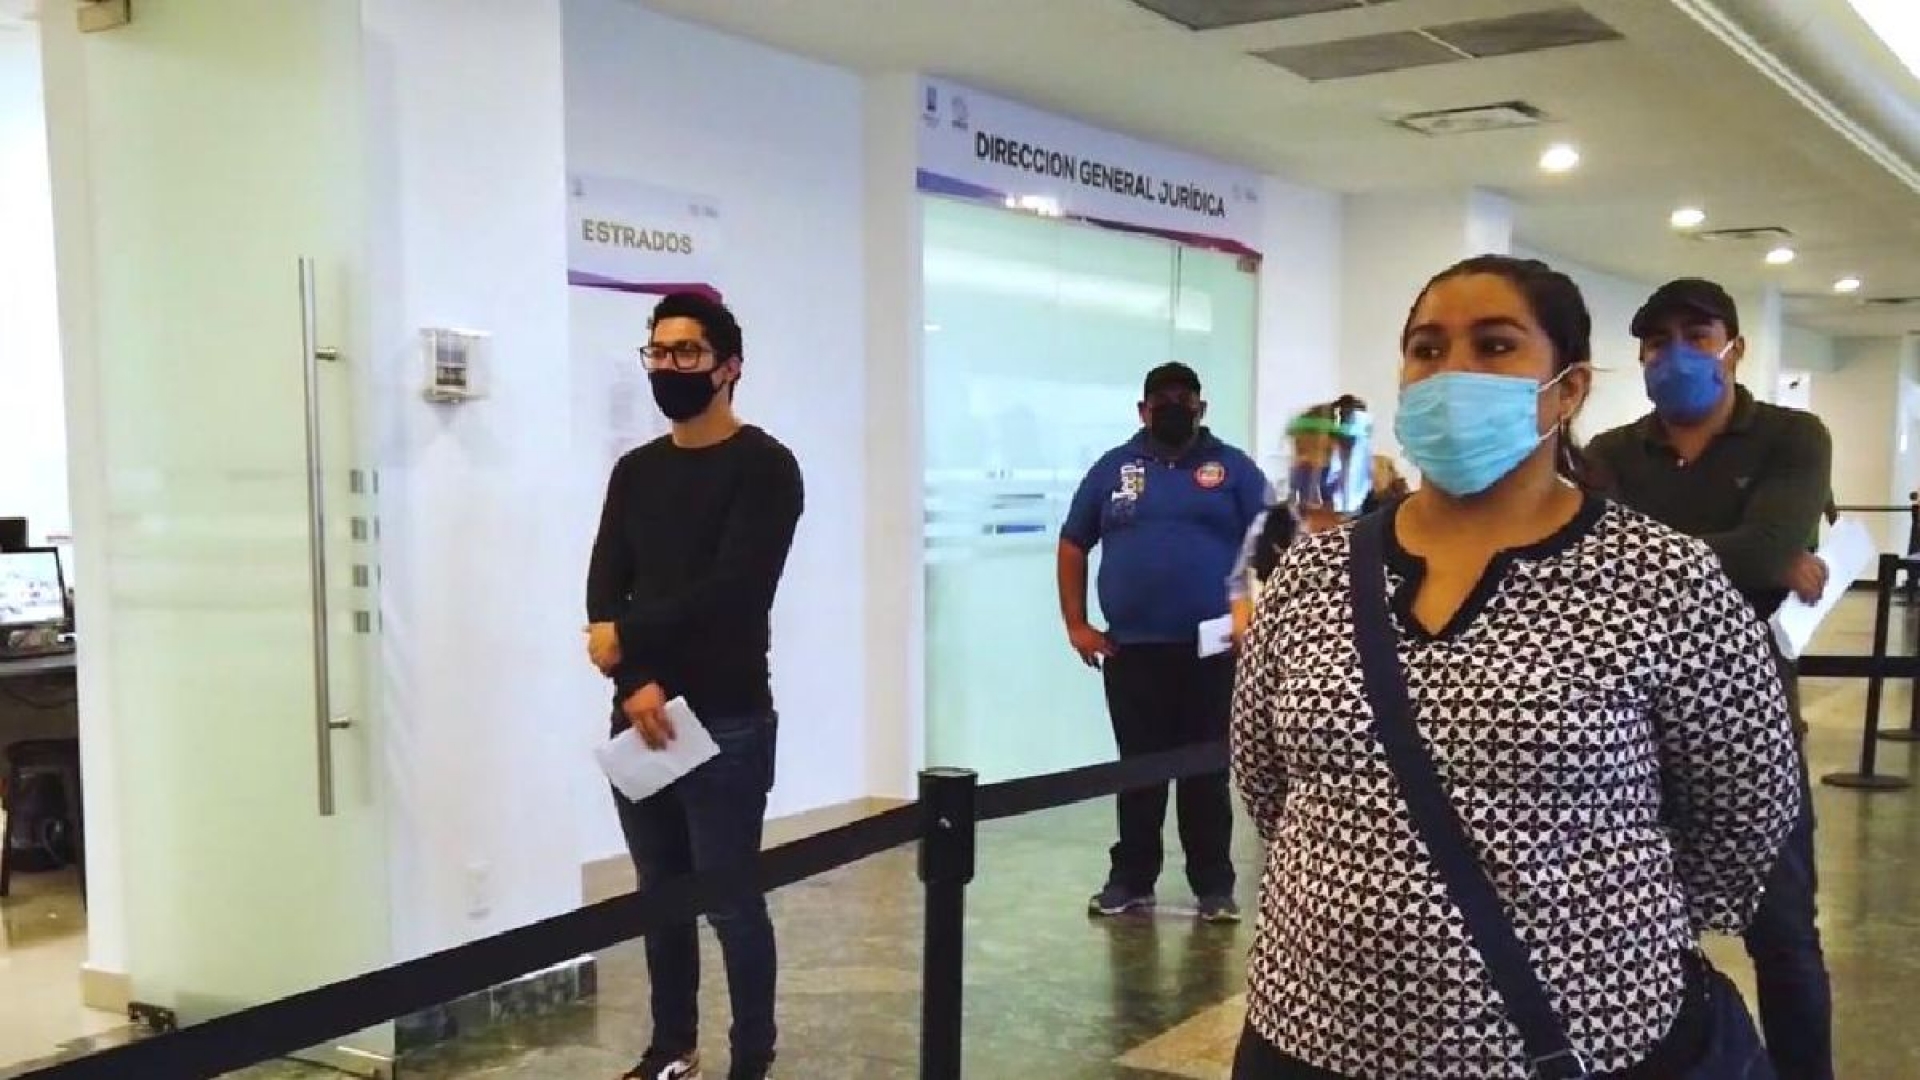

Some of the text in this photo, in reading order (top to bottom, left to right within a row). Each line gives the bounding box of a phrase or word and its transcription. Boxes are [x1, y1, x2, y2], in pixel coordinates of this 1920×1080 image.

[975, 131, 1075, 180] DIRECCION
[1079, 160, 1155, 200] GENERAL
[1158, 181, 1226, 218] JURÍDICA
[582, 219, 693, 254] ESTRADOS
